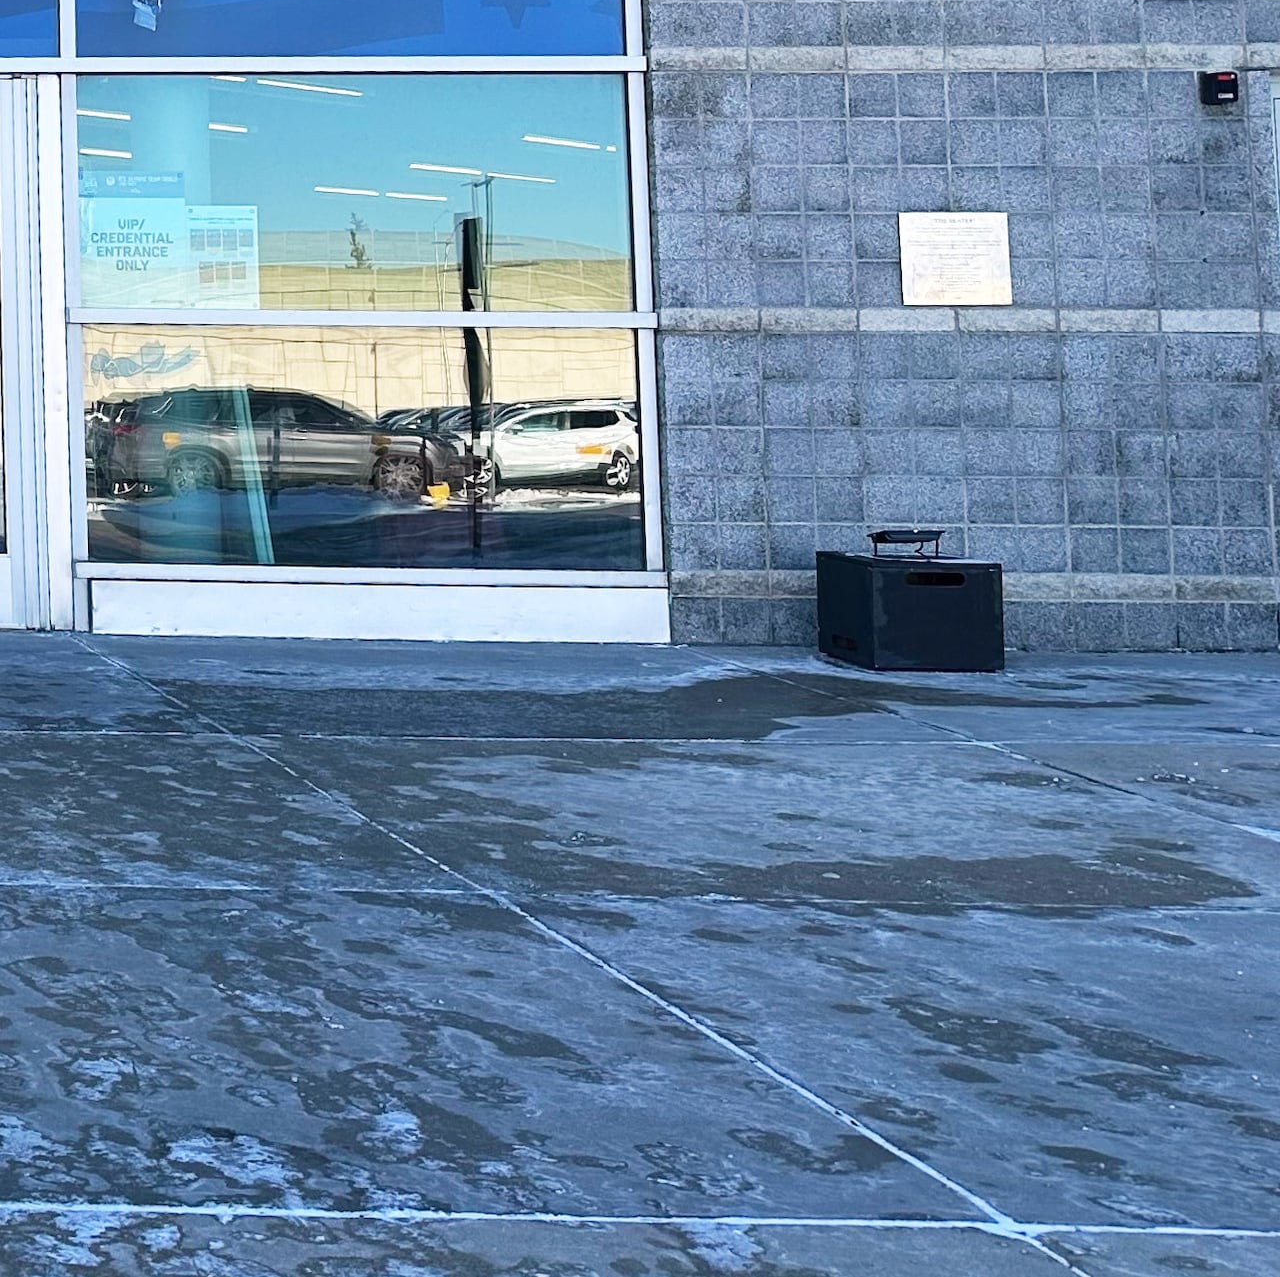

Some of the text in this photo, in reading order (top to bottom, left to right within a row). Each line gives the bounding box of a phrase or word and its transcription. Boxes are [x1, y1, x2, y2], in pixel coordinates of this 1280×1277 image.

[90, 232, 175, 244] CREDENTIAL
[96, 246, 169, 258] ENTRANCE
[116, 259, 150, 271] ONLY
